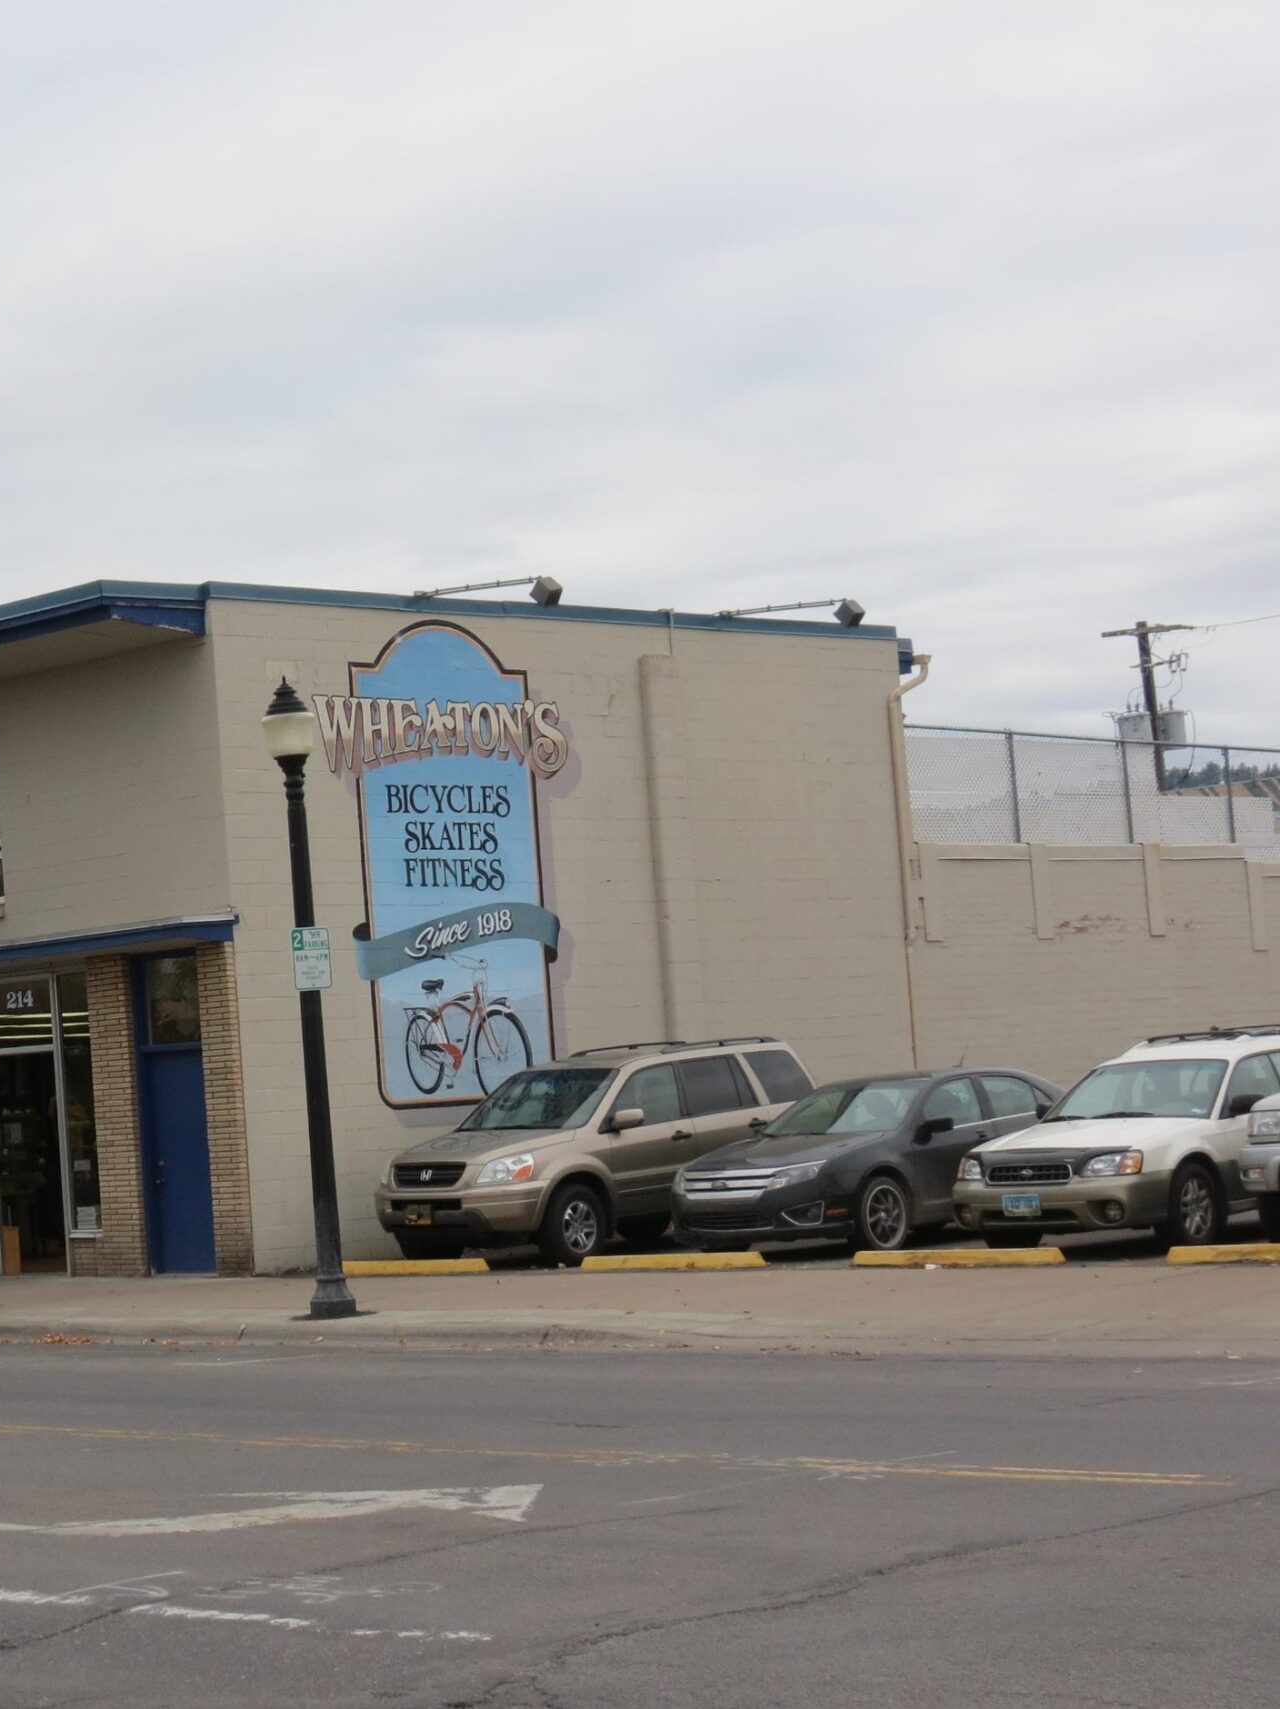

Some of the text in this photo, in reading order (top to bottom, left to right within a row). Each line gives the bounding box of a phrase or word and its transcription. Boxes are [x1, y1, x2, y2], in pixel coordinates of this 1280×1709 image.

[312, 695, 568, 774] WHEATON'S
[385, 784, 511, 818] BICYCLES
[404, 821, 499, 855] SKATES
[404, 858, 506, 892] FITNESS
[292, 932, 303, 948] 2
[405, 909, 513, 958] Since 1918
[6, 990, 34, 1009] 214
